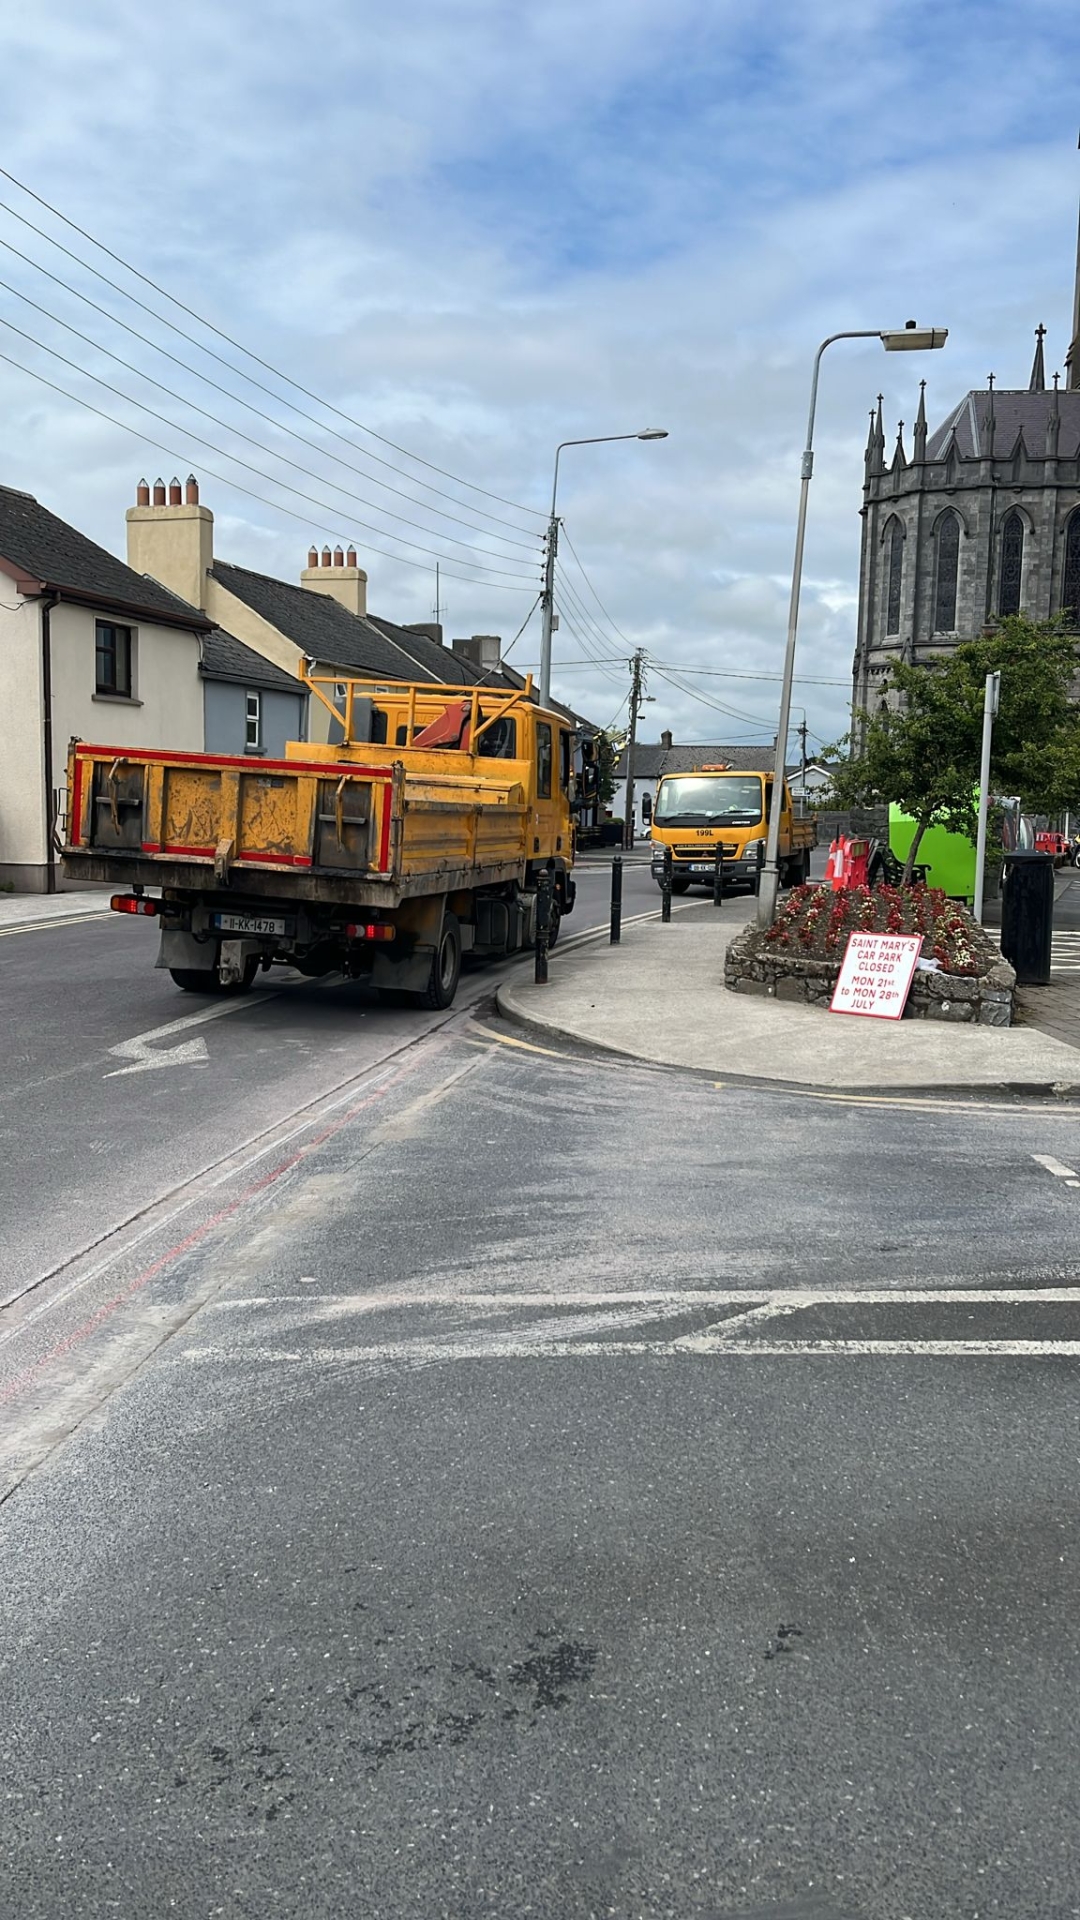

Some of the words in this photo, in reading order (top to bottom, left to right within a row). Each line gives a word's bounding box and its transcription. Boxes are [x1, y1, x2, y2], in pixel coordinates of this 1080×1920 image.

[695, 829, 715, 837] 199L
[229, 918, 275, 933] 11-KK-1478
[851, 938, 878, 949] SAINT
[880, 940, 916, 952] MARY'S
[857, 950, 875, 960] CAR
[877, 951, 903, 963] PARK
[858, 961, 895, 973] CLOSED
[851, 975, 875, 987] MON
[877, 978, 895, 988] 21st
[840, 986, 850, 996] to
[852, 987, 877, 998] MON
[878, 990, 900, 1000] 28th
[850, 999, 875, 1010] JULY
